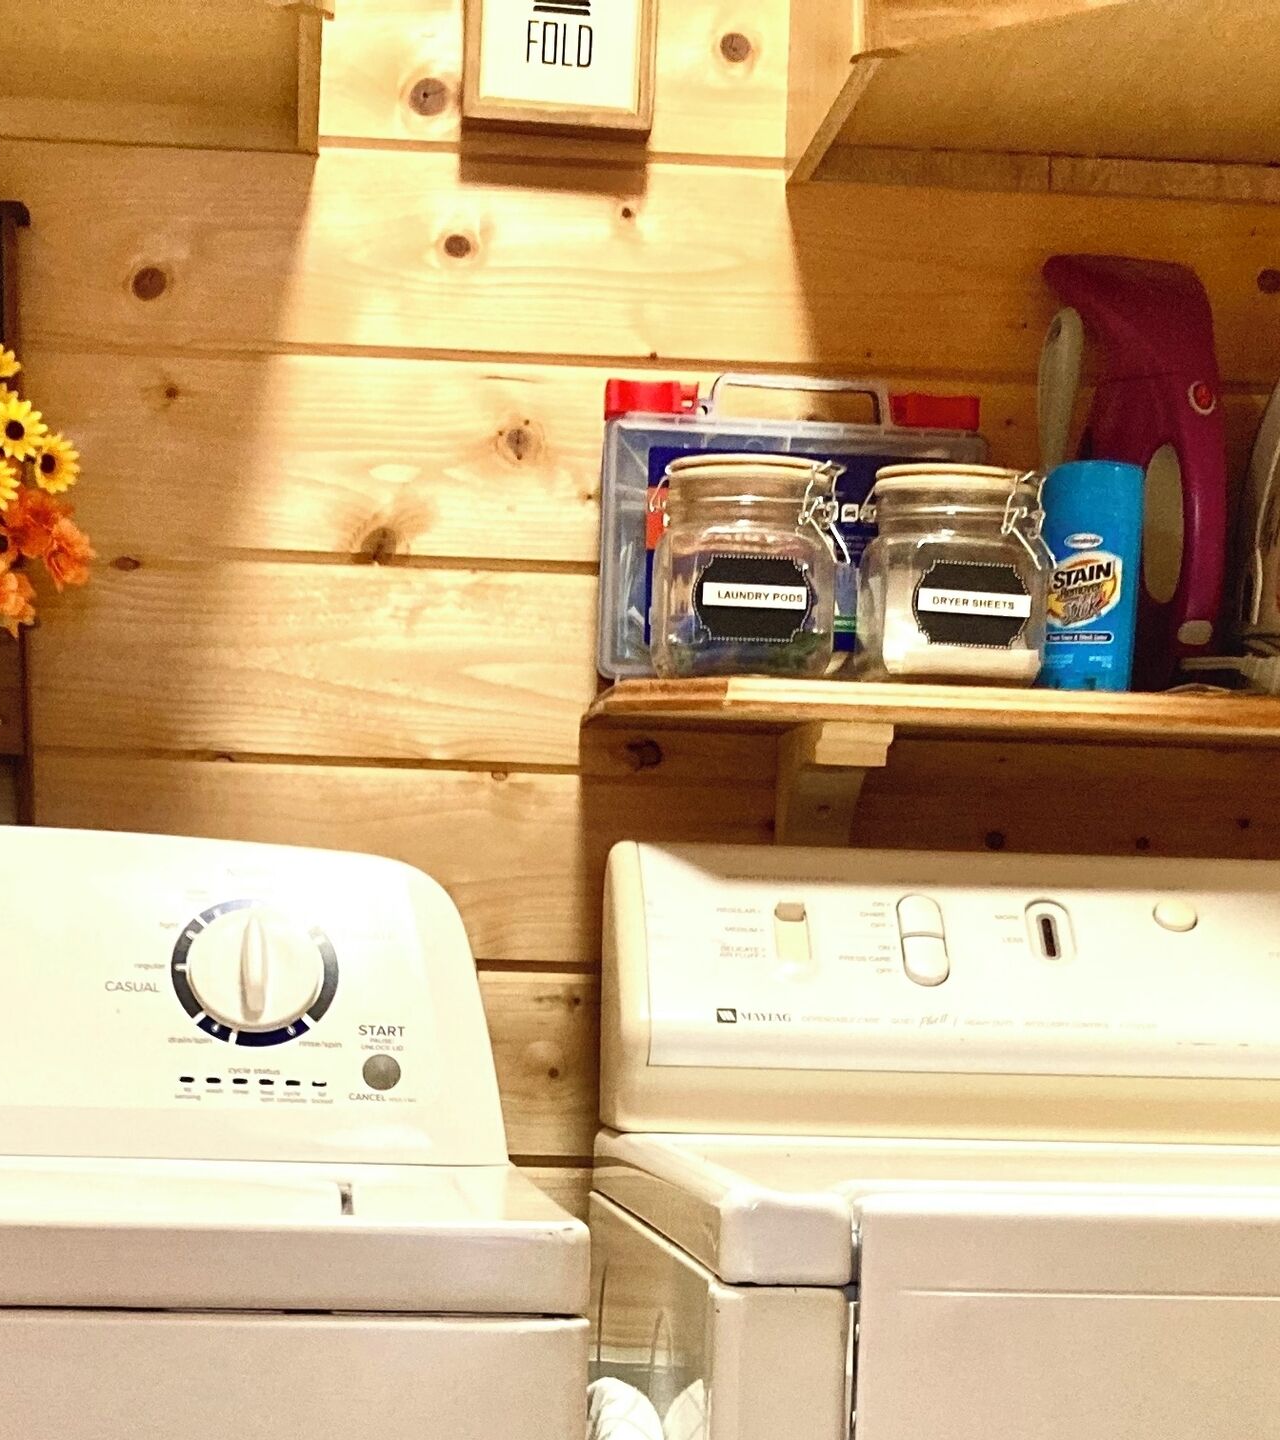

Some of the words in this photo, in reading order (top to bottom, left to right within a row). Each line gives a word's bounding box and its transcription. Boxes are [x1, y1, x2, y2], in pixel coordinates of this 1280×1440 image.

[526, 20, 593, 67] FOLD
[1053, 562, 1112, 589] STAIN
[717, 590, 770, 602] LAUNDRY
[773, 592, 804, 603] PODS
[932, 595, 970, 608] DRYER
[972, 598, 1015, 611] SHEETS
[105, 981, 161, 994] CASUAL
[740, 1012, 792, 1022] MAYTAG
[358, 1024, 406, 1037] START
[348, 1093, 387, 1102] CANCEL
